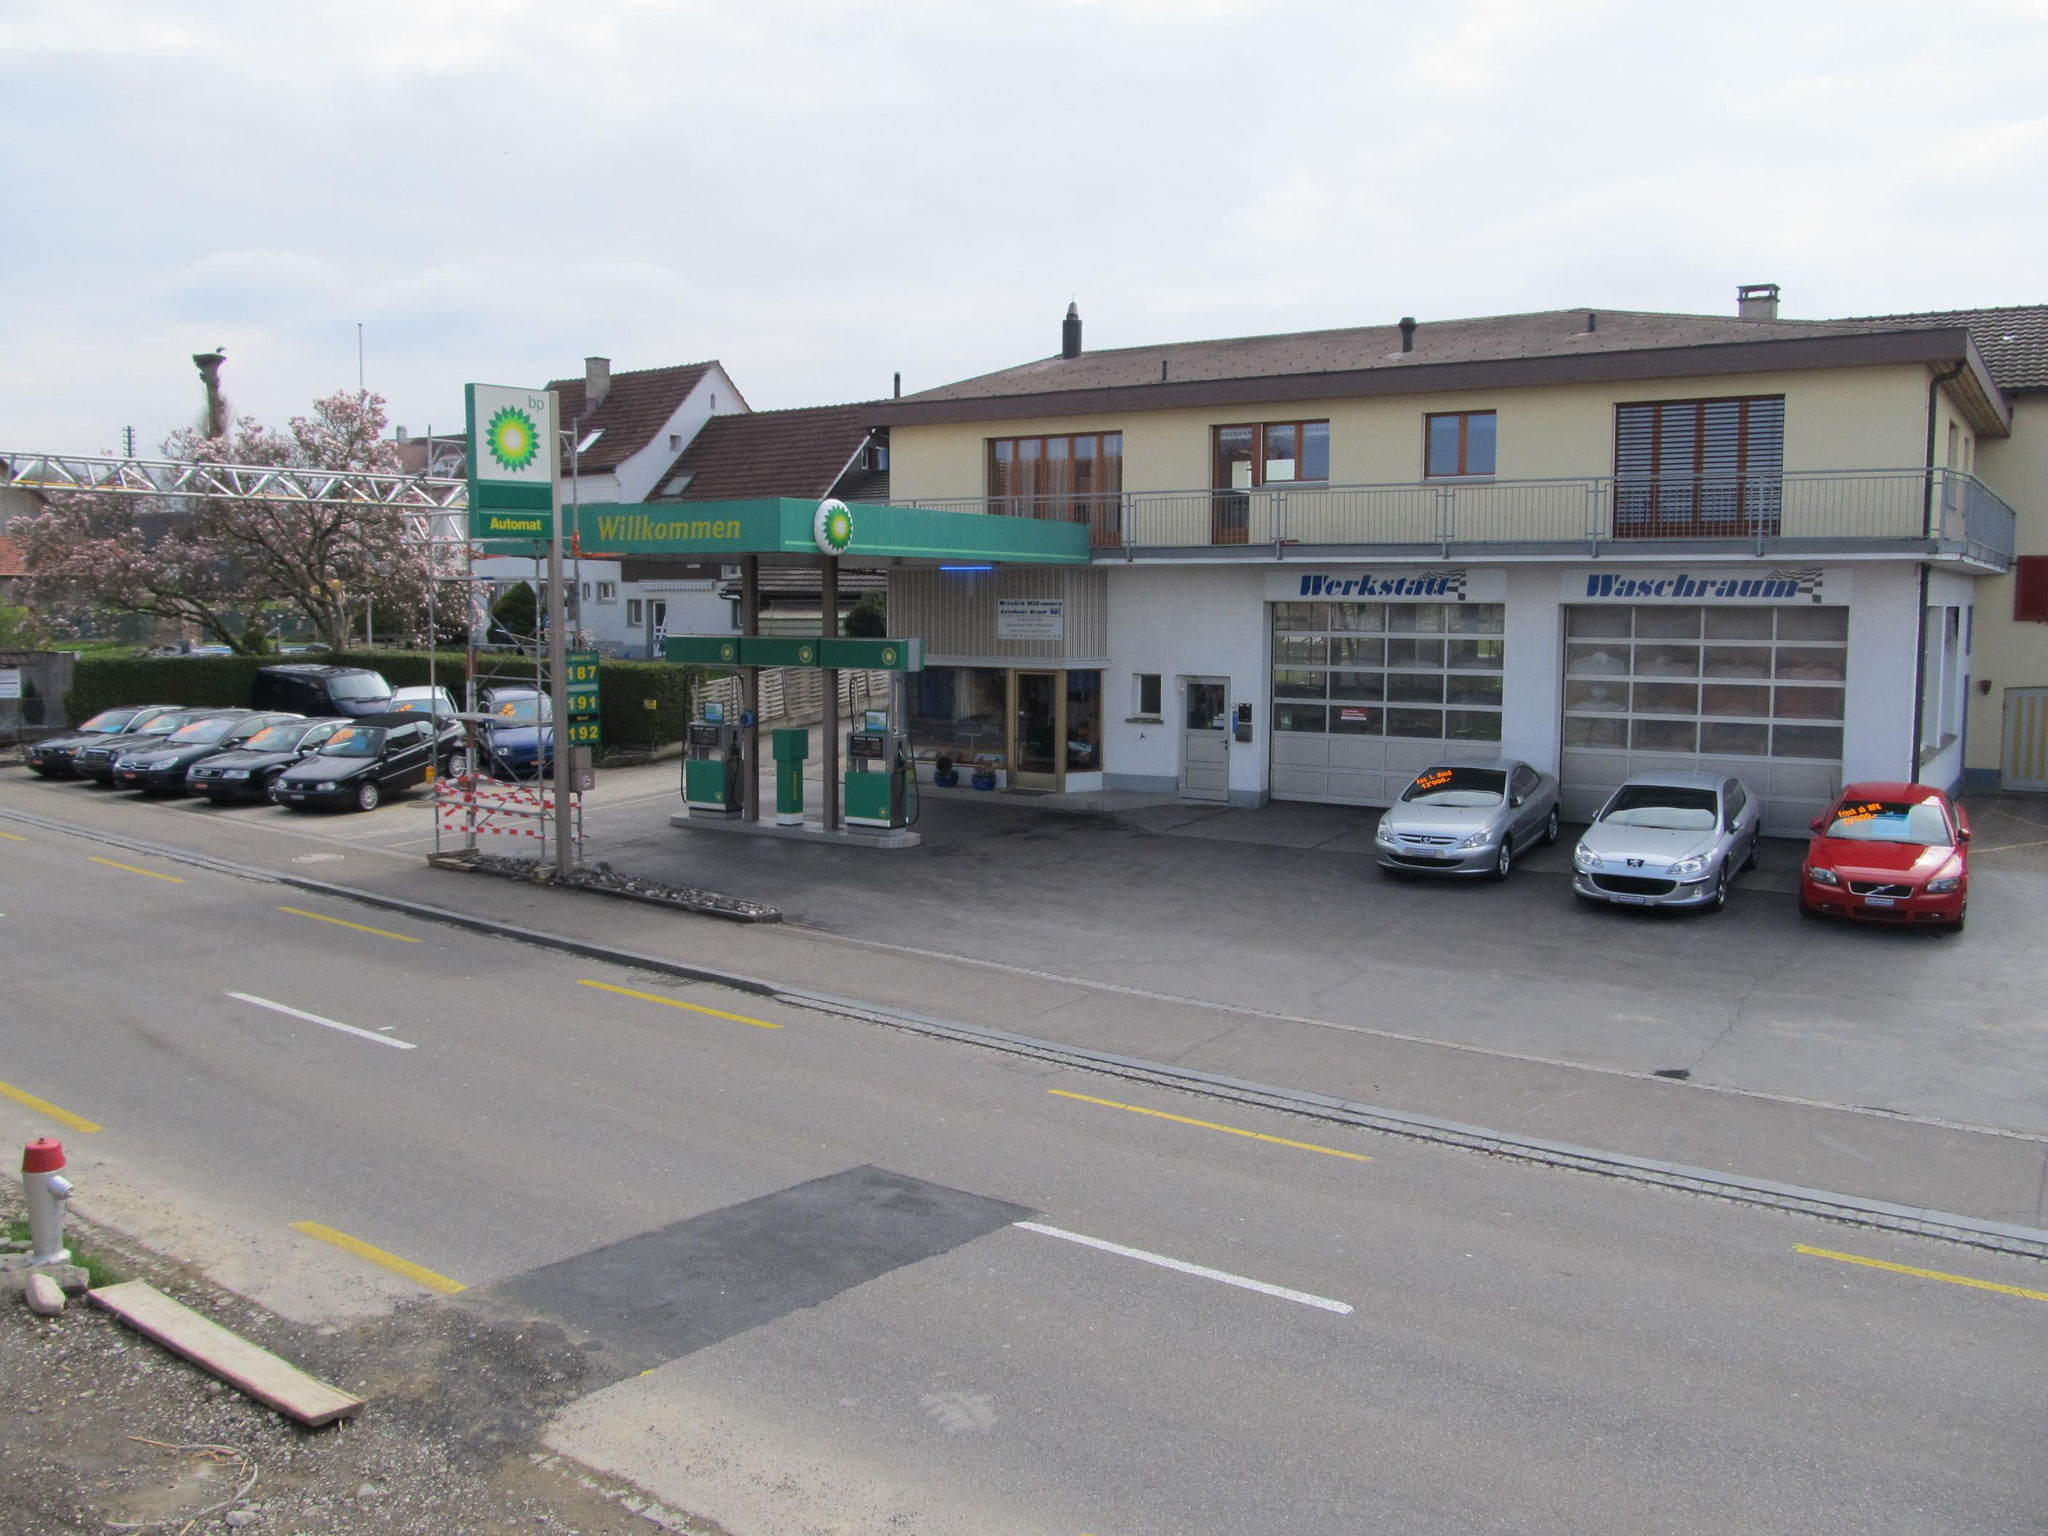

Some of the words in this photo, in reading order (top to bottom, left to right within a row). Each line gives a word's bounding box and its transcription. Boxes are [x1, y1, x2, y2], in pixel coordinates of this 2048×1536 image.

[528, 395, 545, 413] bp
[489, 516, 542, 531] Automat
[597, 515, 741, 542] Willkommen
[1300, 574, 1449, 596] Werkstatt
[1586, 573, 1799, 598] Waschraum
[566, 665, 597, 681] 187
[567, 695, 597, 711] 191
[568, 725, 599, 741] 192
